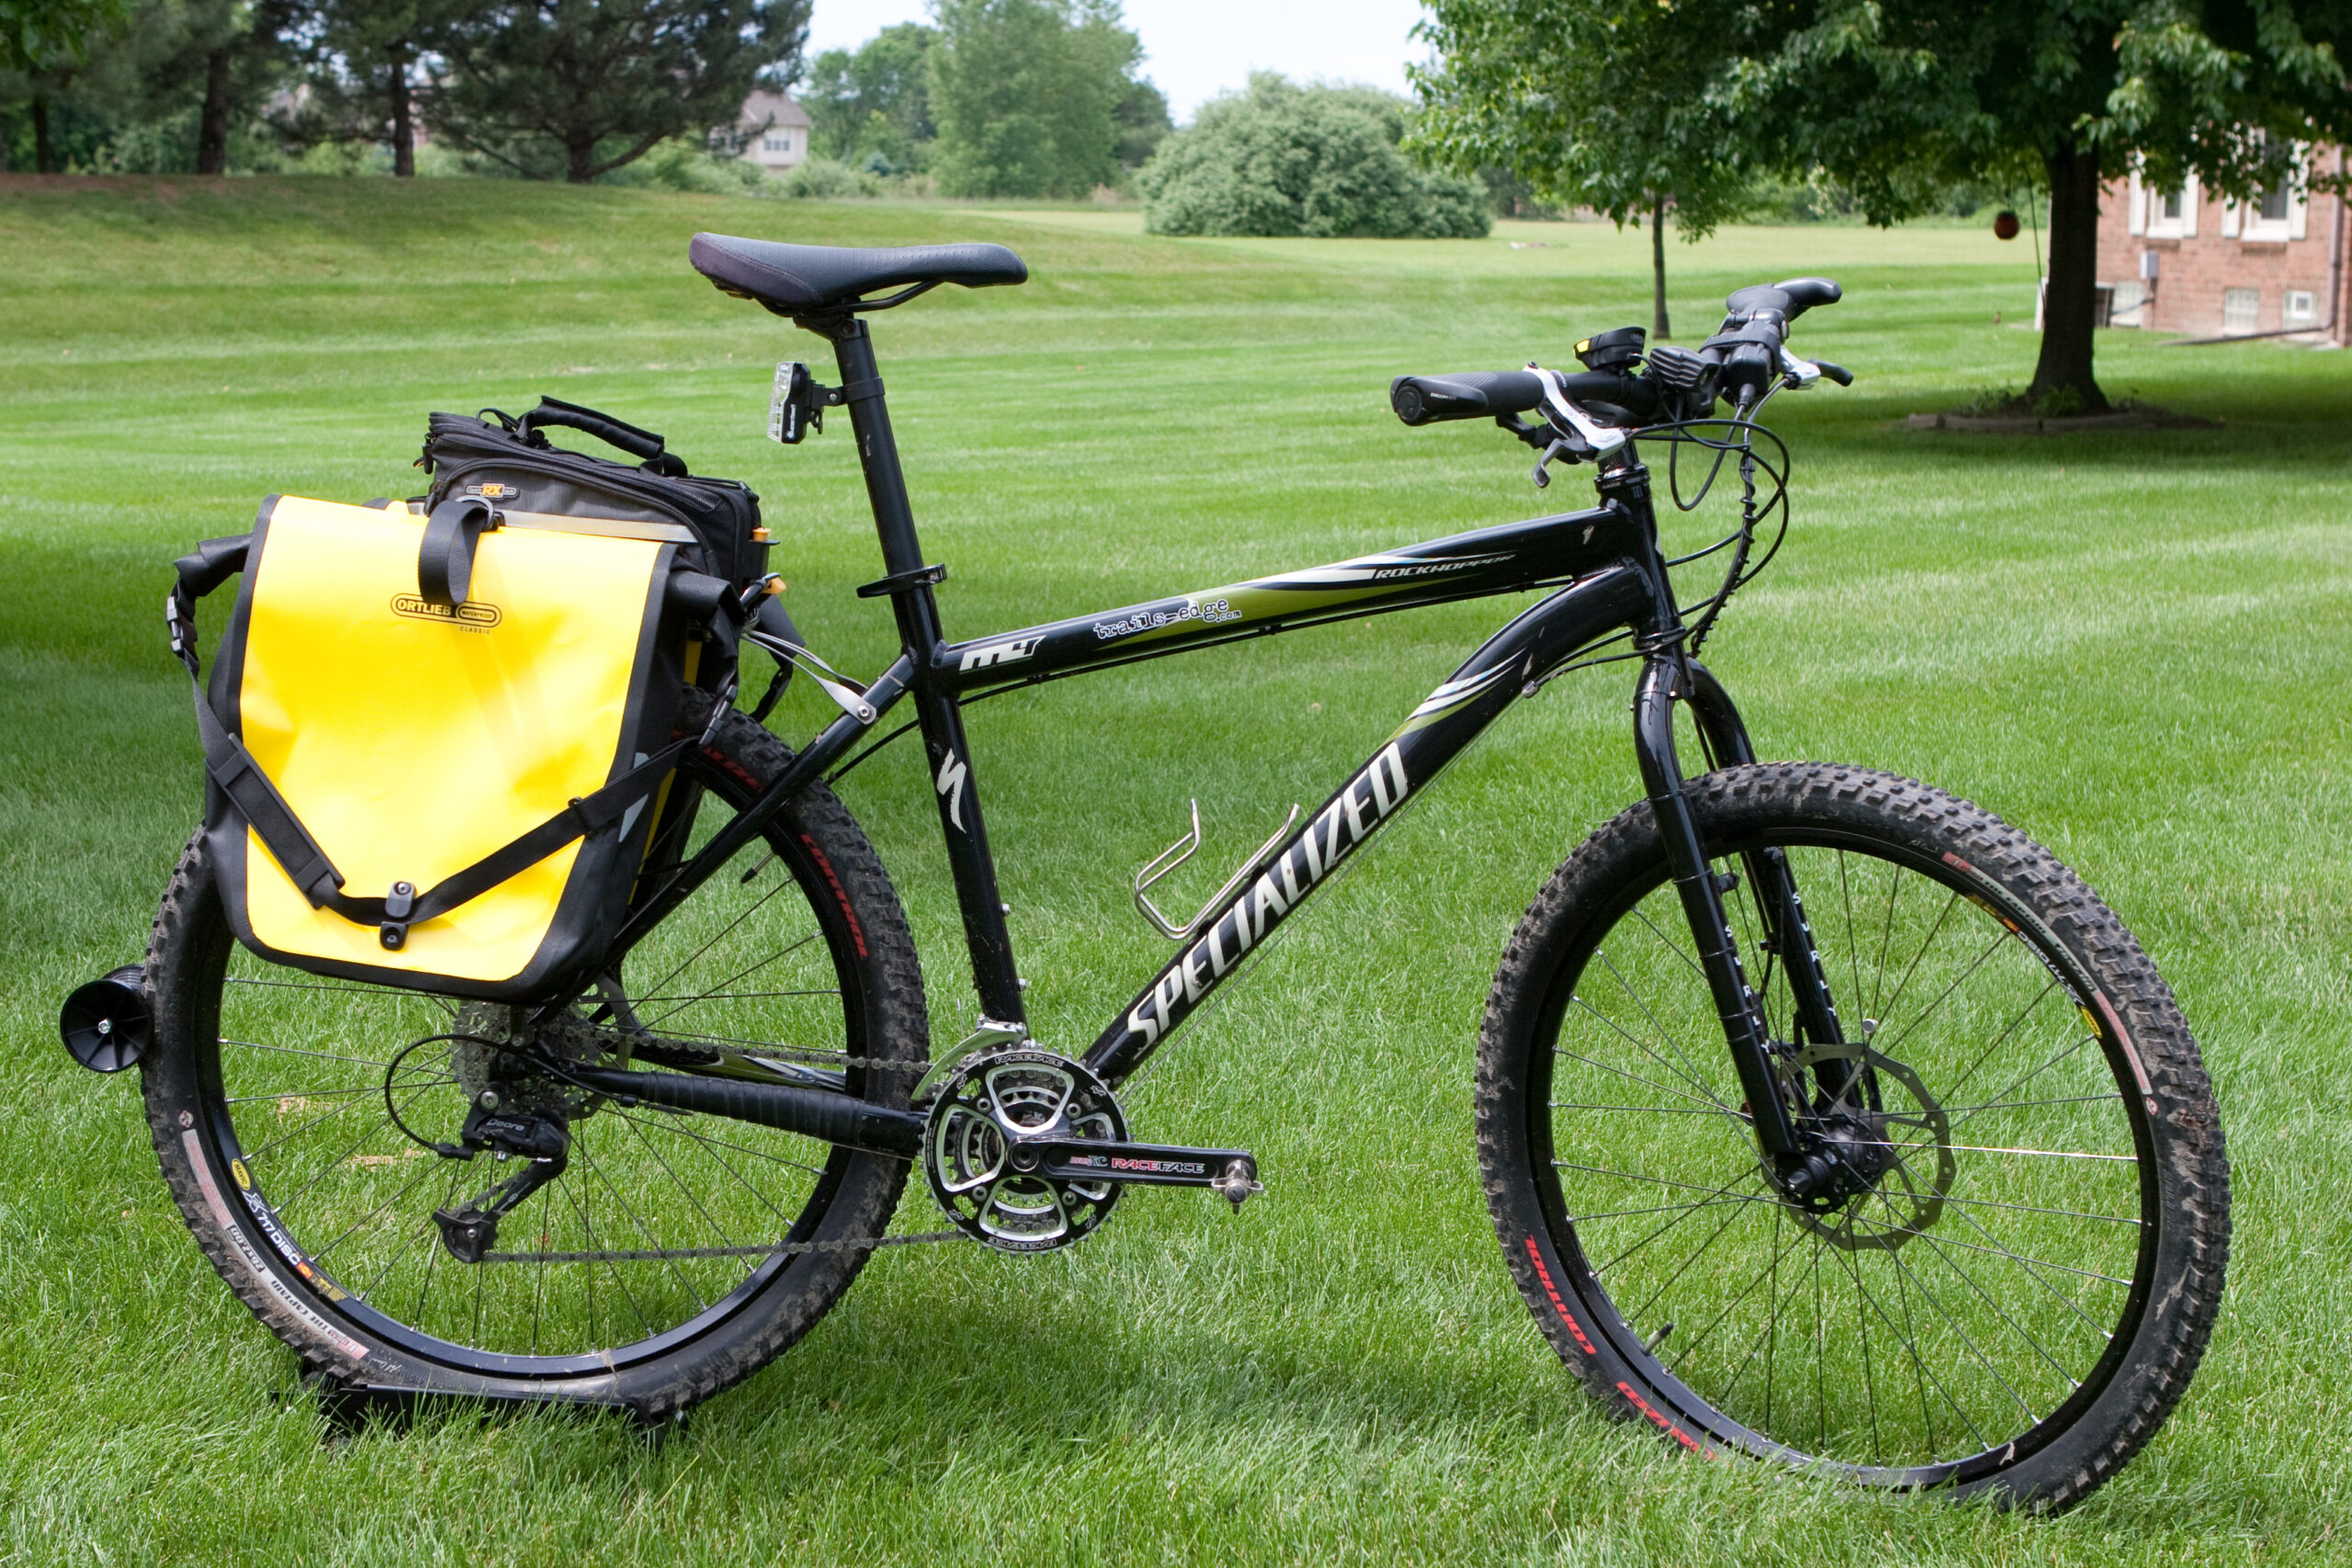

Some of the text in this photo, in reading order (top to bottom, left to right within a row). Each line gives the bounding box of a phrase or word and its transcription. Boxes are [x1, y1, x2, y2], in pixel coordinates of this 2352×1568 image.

[482, 485, 503, 496] RX
[1375, 554, 1516, 580] ROCKHOPPER
[397, 600, 451, 616] ORTLIEB
[461, 609, 492, 619] WATERPROOF
[459, 625, 491, 635] CLASSIC
[1126, 740, 1408, 1062] SPECIALIZED
[1792, 891, 1837, 1017] SURLY
[1724, 924, 1770, 1054] SURLY
[486, 1118, 525, 1132] Deore
[234, 1164, 247, 1185] MAVIC
[230, 1226, 265, 1272] 26x2.00
[257, 1212, 301, 1266] 717 DISC
[271, 1280, 309, 1315] CAPTAIN
[1525, 1234, 1597, 1355] CONTROL
[309, 1315, 329, 1330] THE
